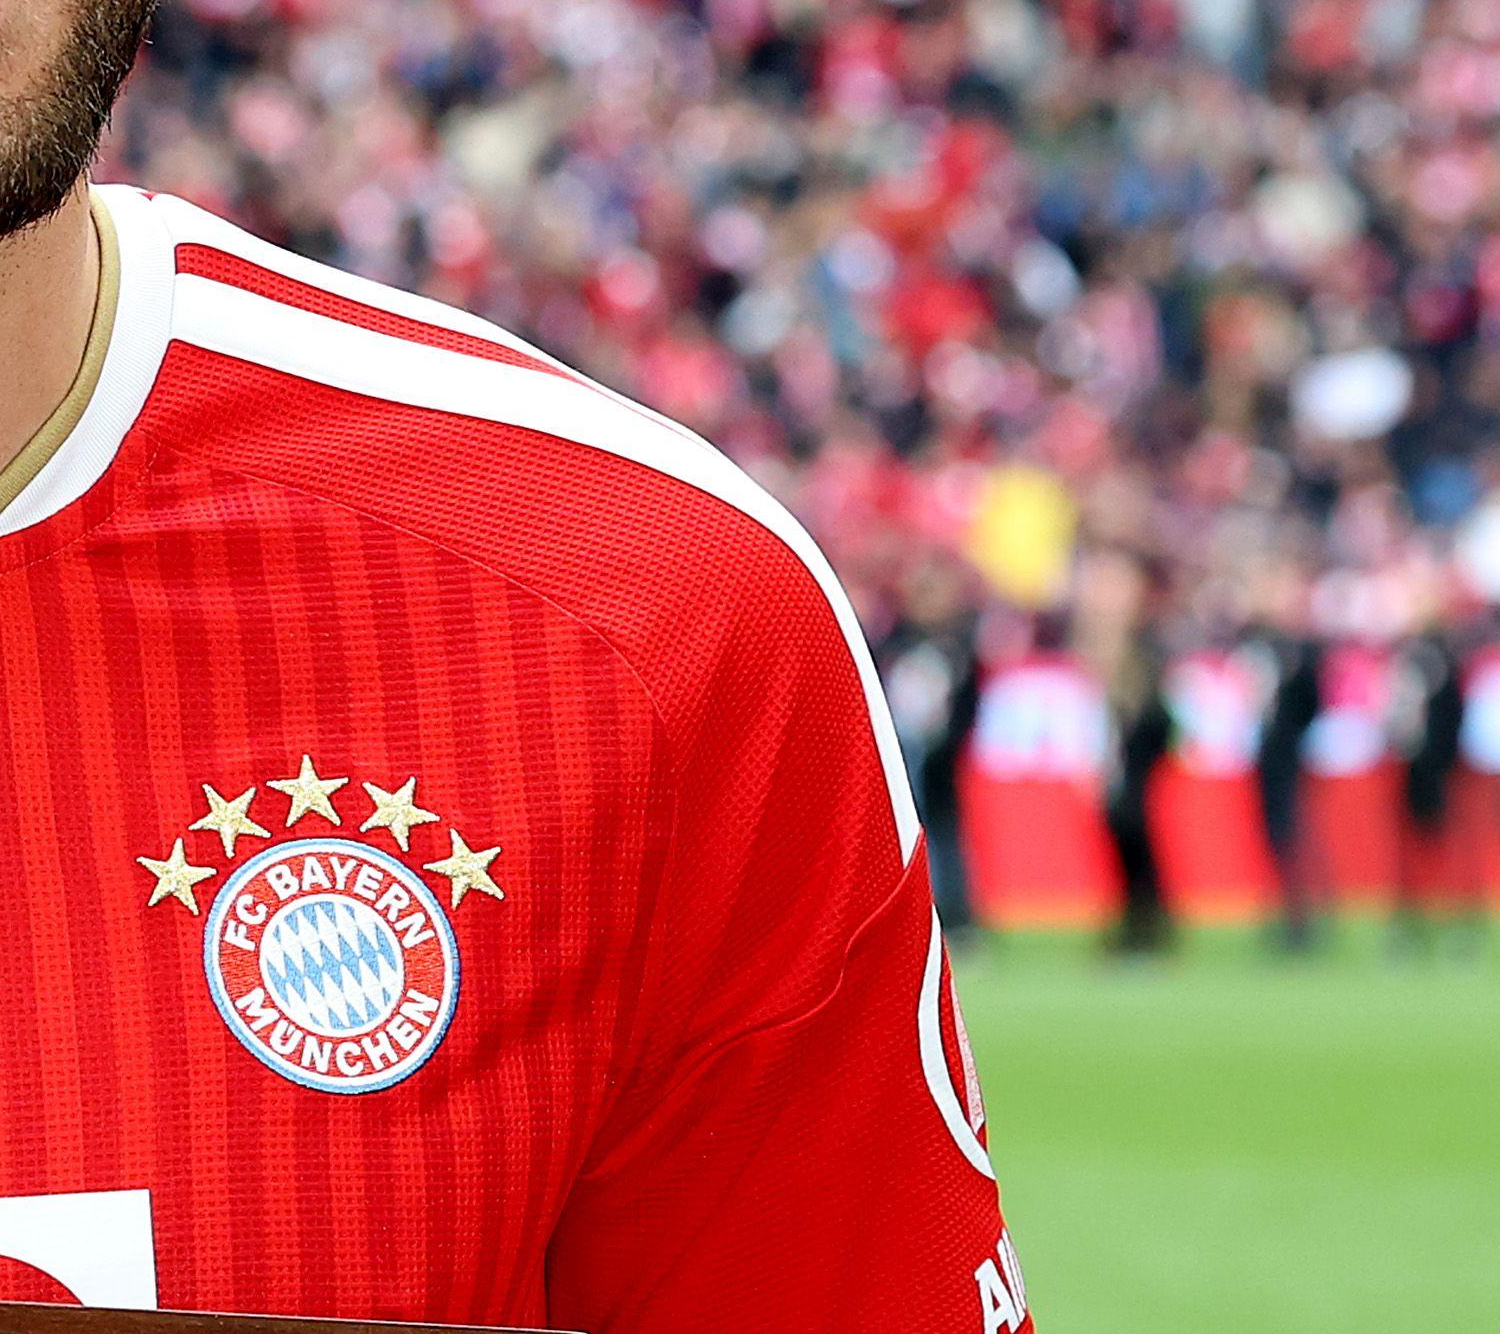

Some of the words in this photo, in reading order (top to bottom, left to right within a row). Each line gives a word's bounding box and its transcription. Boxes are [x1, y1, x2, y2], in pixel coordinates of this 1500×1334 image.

[224, 894, 268, 951] FC
[265, 856, 436, 949] BAYERN
[235, 988, 440, 1076] MÜNCHEN
